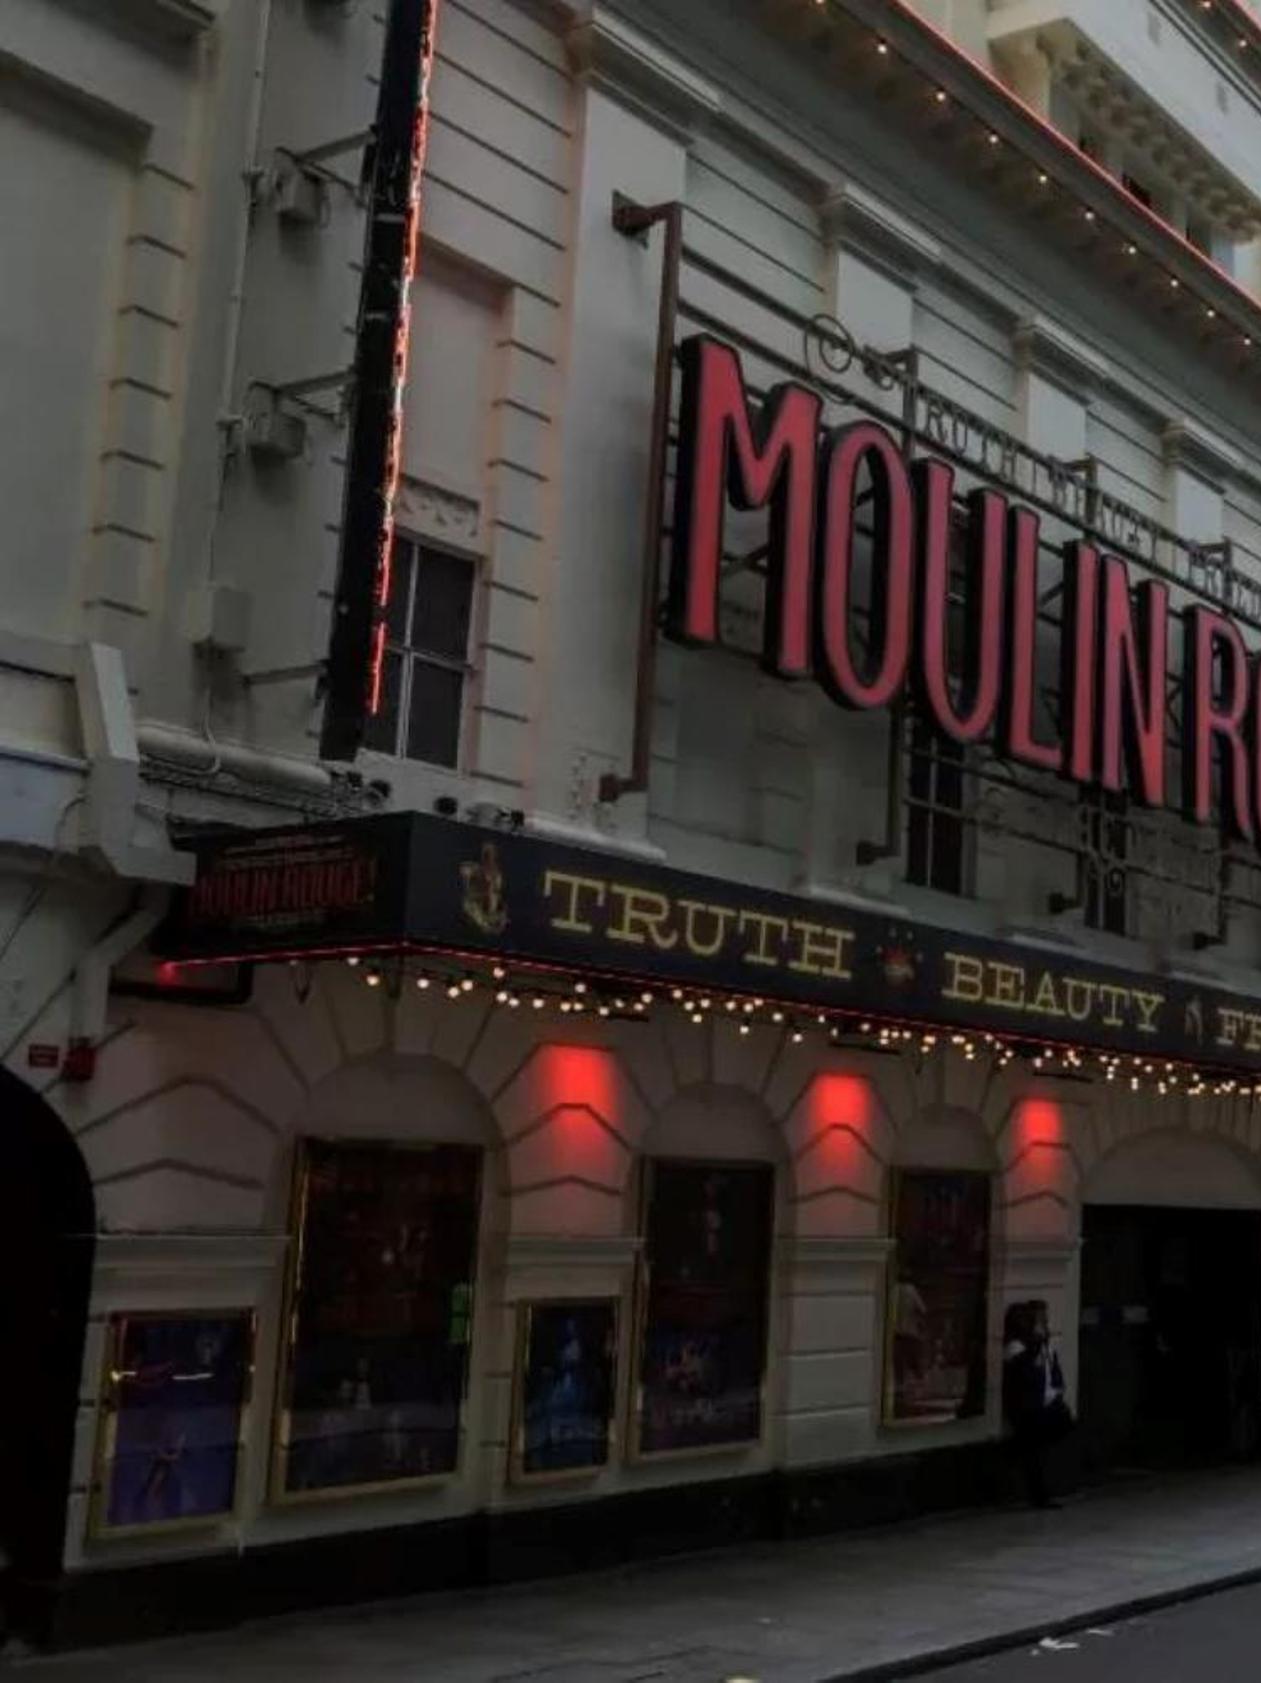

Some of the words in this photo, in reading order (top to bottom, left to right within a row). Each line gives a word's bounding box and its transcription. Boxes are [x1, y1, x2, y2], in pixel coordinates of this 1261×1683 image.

[664, 333, 1171, 811] MOULIN
[544, 870, 855, 979] TRUTH
[941, 951, 1165, 1033] BEAUTY
